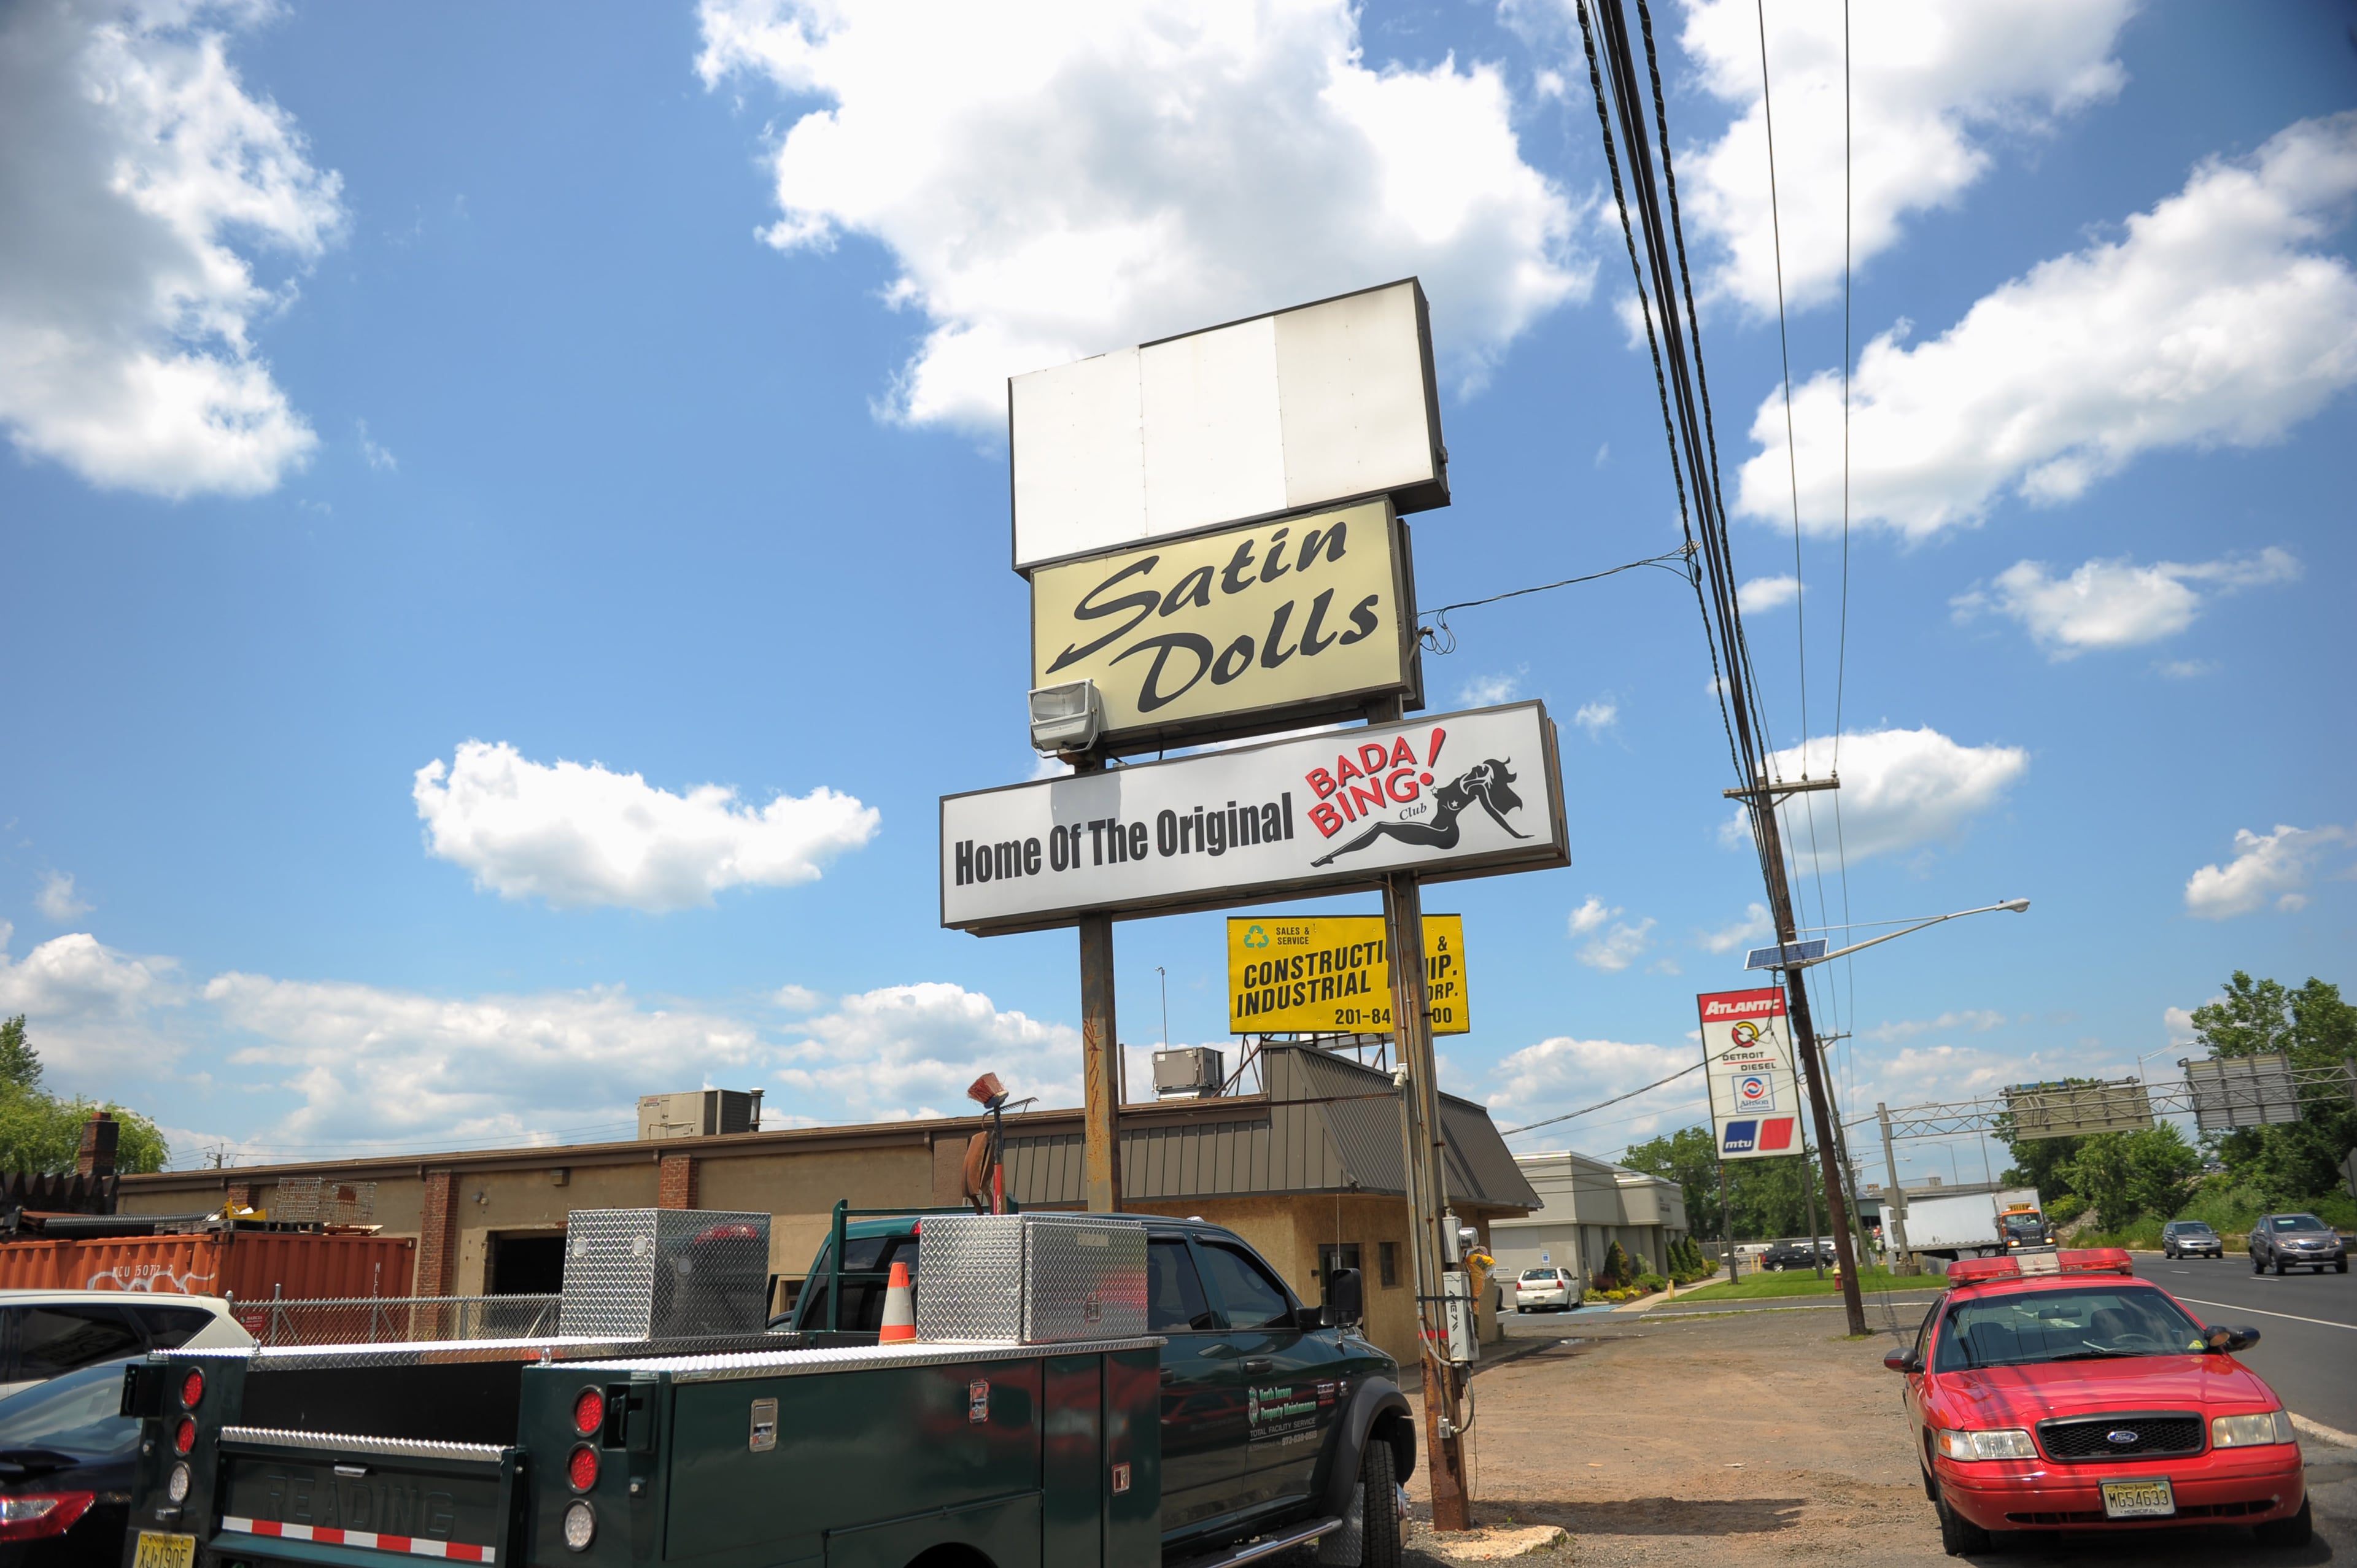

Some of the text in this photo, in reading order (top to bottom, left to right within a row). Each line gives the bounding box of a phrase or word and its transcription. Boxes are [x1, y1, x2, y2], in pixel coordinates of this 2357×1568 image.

[1046, 522, 1347, 674] Satin
[1109, 588, 1379, 713] Dolls
[1399, 803, 1427, 821] Club
[956, 792, 1294, 886] Home Of The Original
[1277, 937, 1309, 945] SERVICE
[1244, 936, 1447, 989] CONSTRUCTI &
[1237, 970, 1371, 1018] INDUSTRIAL
[1723, 1052, 1764, 1061] DETROIT
[1725, 1140, 1752, 1149] mtu
[1260, 1387, 1291, 1402] North Jersey
[1261, 1401, 1316, 1422] Property Maintenance
[1250, 1417, 1316, 1437] TOTAL FACILITY SERVICE
[2108, 1490, 2169, 1507] MG54633
